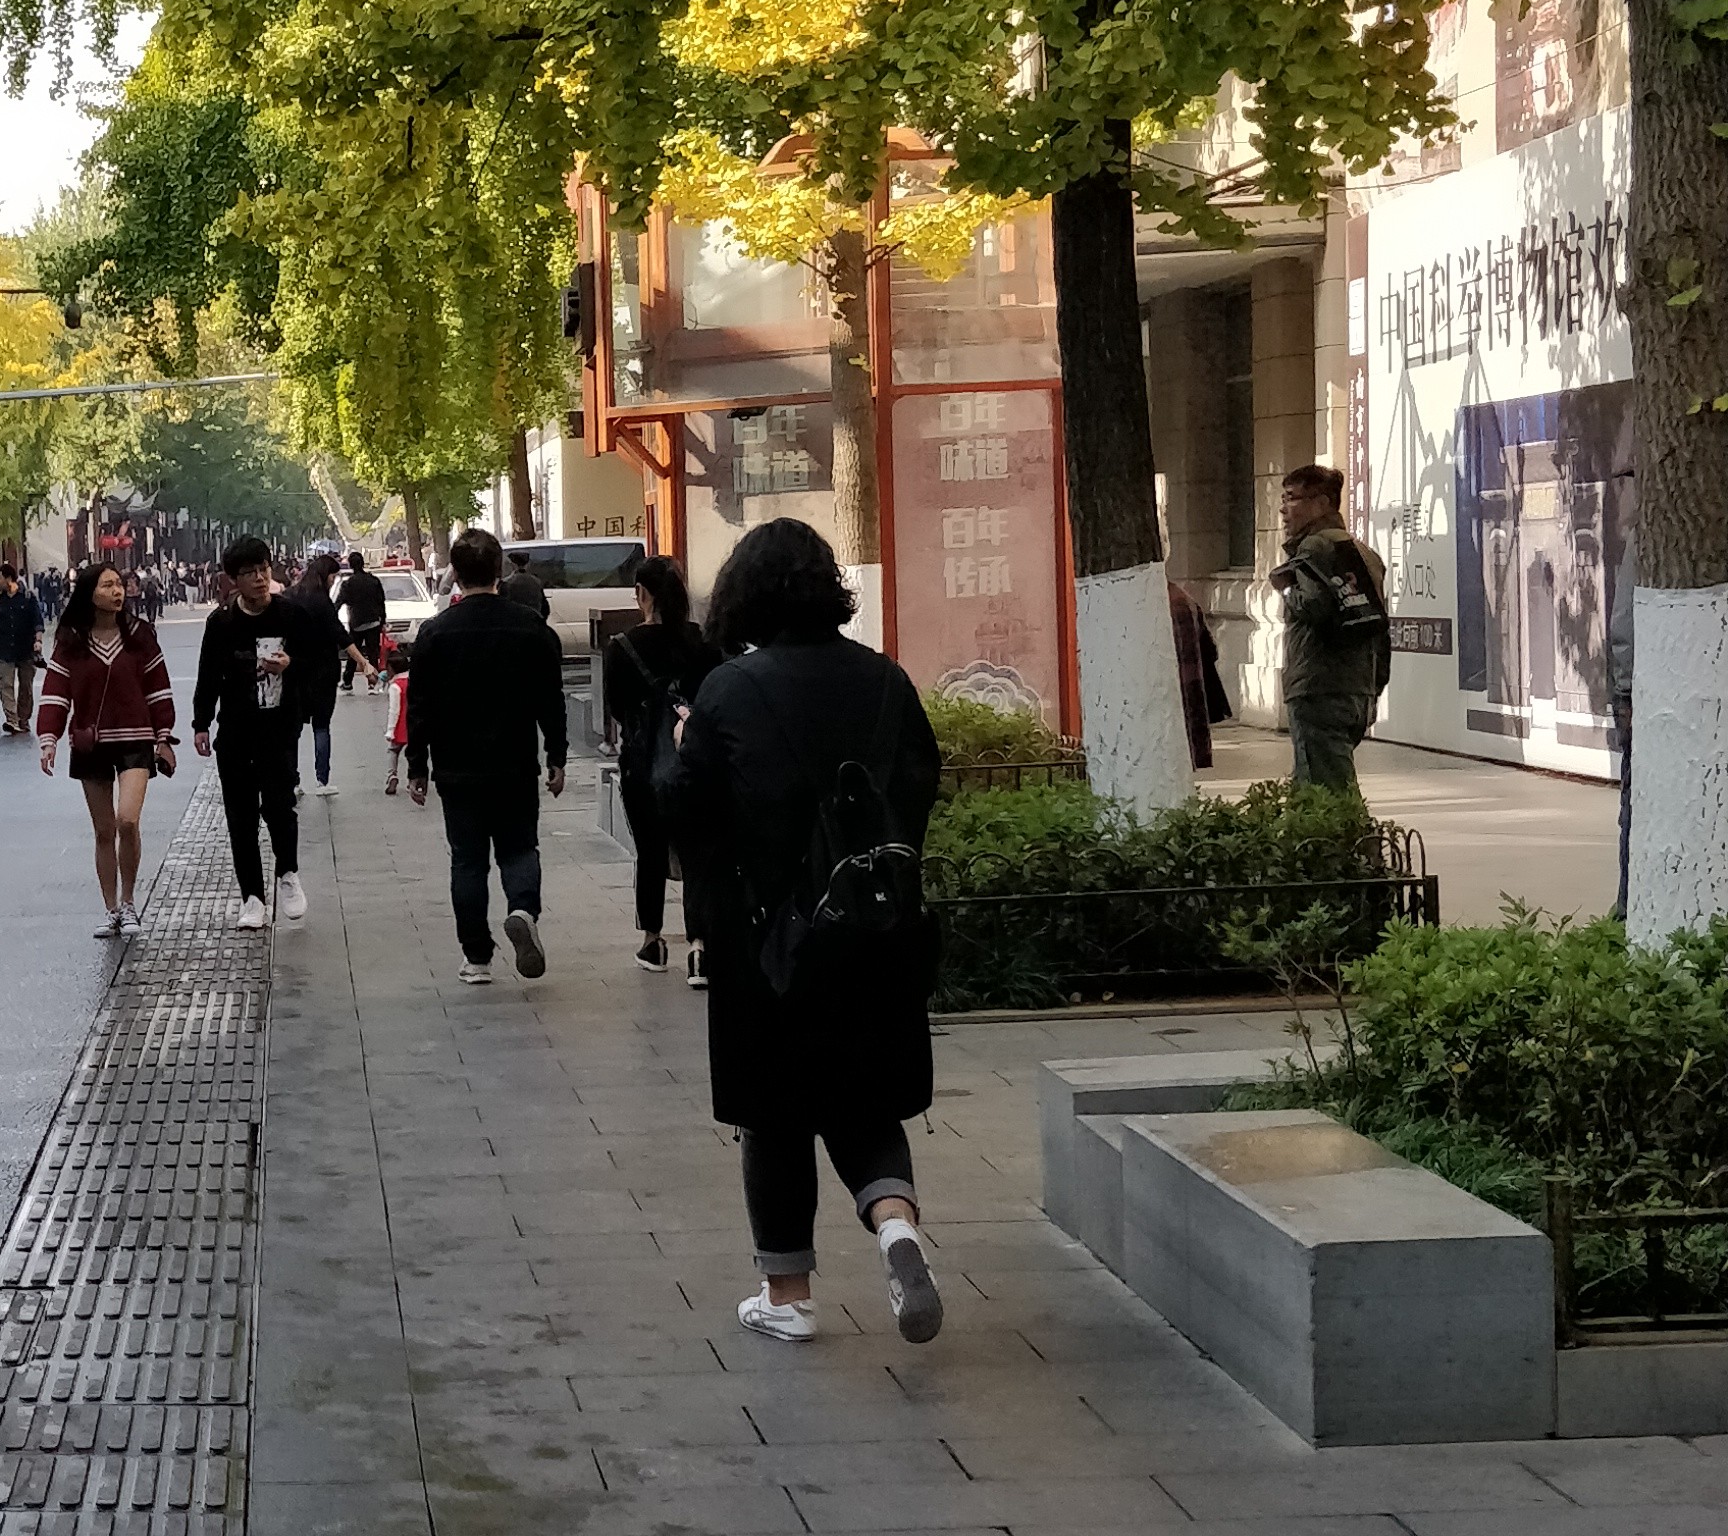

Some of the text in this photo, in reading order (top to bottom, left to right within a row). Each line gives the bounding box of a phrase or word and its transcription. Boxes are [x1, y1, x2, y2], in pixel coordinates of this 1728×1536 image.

[940, 392, 1007, 432] 百年
[733, 450, 810, 494] 味道
[939, 438, 1011, 481] 味道
[941, 506, 1010, 549] 百年
[943, 556, 1012, 599] 传承
